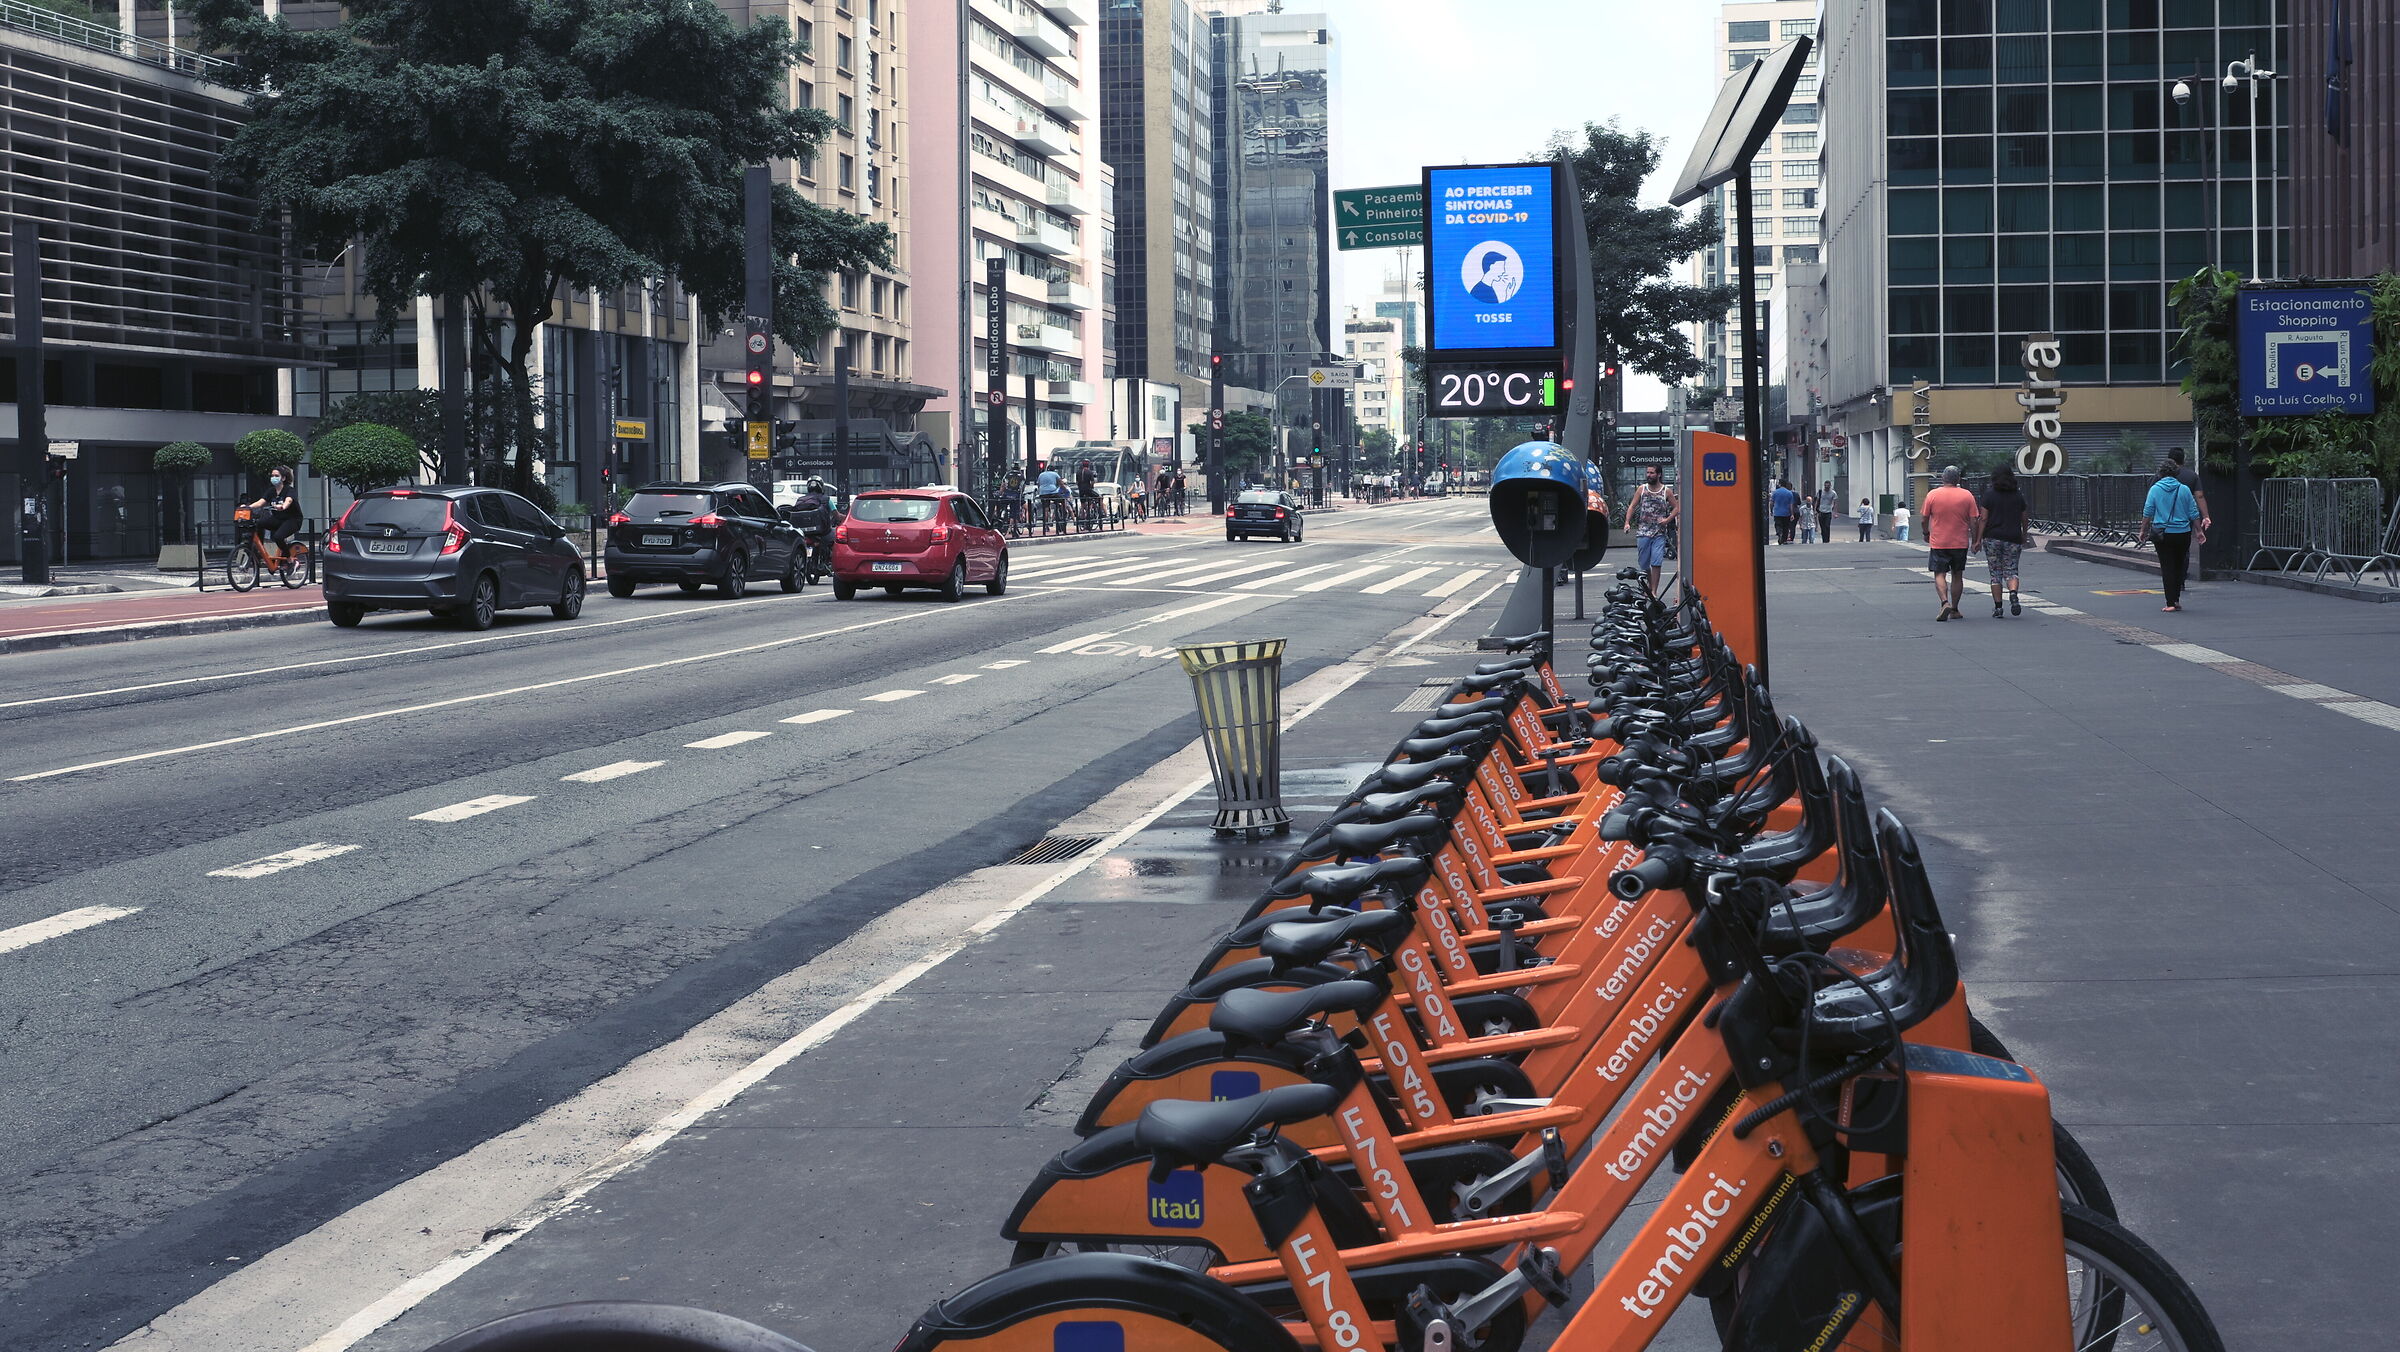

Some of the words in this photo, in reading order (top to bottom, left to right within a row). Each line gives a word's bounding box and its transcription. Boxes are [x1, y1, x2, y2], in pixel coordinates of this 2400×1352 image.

[1364, 192, 1422, 205] Pacaemb
[1445, 187, 1464, 198] AO
[1467, 185, 1532, 197] PERCEBER
[1445, 199, 1513, 211] SINTOMAS
[1365, 230, 1422, 242] Consolaç
[1445, 214, 1464, 224] DA
[1467, 212, 1528, 224] COVID-19
[990, 286, 999, 313] Lobo
[1475, 313, 1513, 323] TOSSE
[2250, 298, 2365, 311] Estacionamento
[2278, 315, 2337, 327] Shopping
[990, 316, 999, 364] Haddock
[2268, 342, 2276, 373] Paulista
[2295, 334, 2324, 342] Augusta
[990, 365, 999, 377] R.
[1440, 372, 1531, 406] 20°C
[2268, 375, 2276, 386] Av.
[2340, 357, 2348, 386] Coelho
[2017, 340, 2063, 475] Safra
[2255, 395, 2275, 405] Rua
[2279, 394, 2299, 405] Luís
[2303, 393, 2346, 406] Coelho,
[2350, 393, 2363, 403] 91
[1906, 385, 1937, 461] SAFRA
[1705, 467, 1734, 482] Itaú
[1513, 714, 1539, 760] H016
[1480, 765, 1513, 819] F301
[1491, 748, 1521, 801] F498
[1467, 791, 1504, 849] F234
[1454, 821, 1491, 887] F617
[1438, 853, 1480, 926] F631
[1420, 887, 1467, 971] G065
[1596, 914, 1676, 1002] tembici.
[1400, 949, 1455, 1037] G404
[1596, 982, 1687, 1083] tembici.
[1373, 1012, 1436, 1119] F045
[1603, 1064, 1712, 1183] tembici.
[1342, 1106, 1413, 1228] F731
[1151, 1195, 1200, 1220] Itaú
[1721, 1173, 1796, 1269] #issomudaomund
[1620, 1172, 1747, 1319] tembici.
[1290, 1233, 1368, 1352] F78
